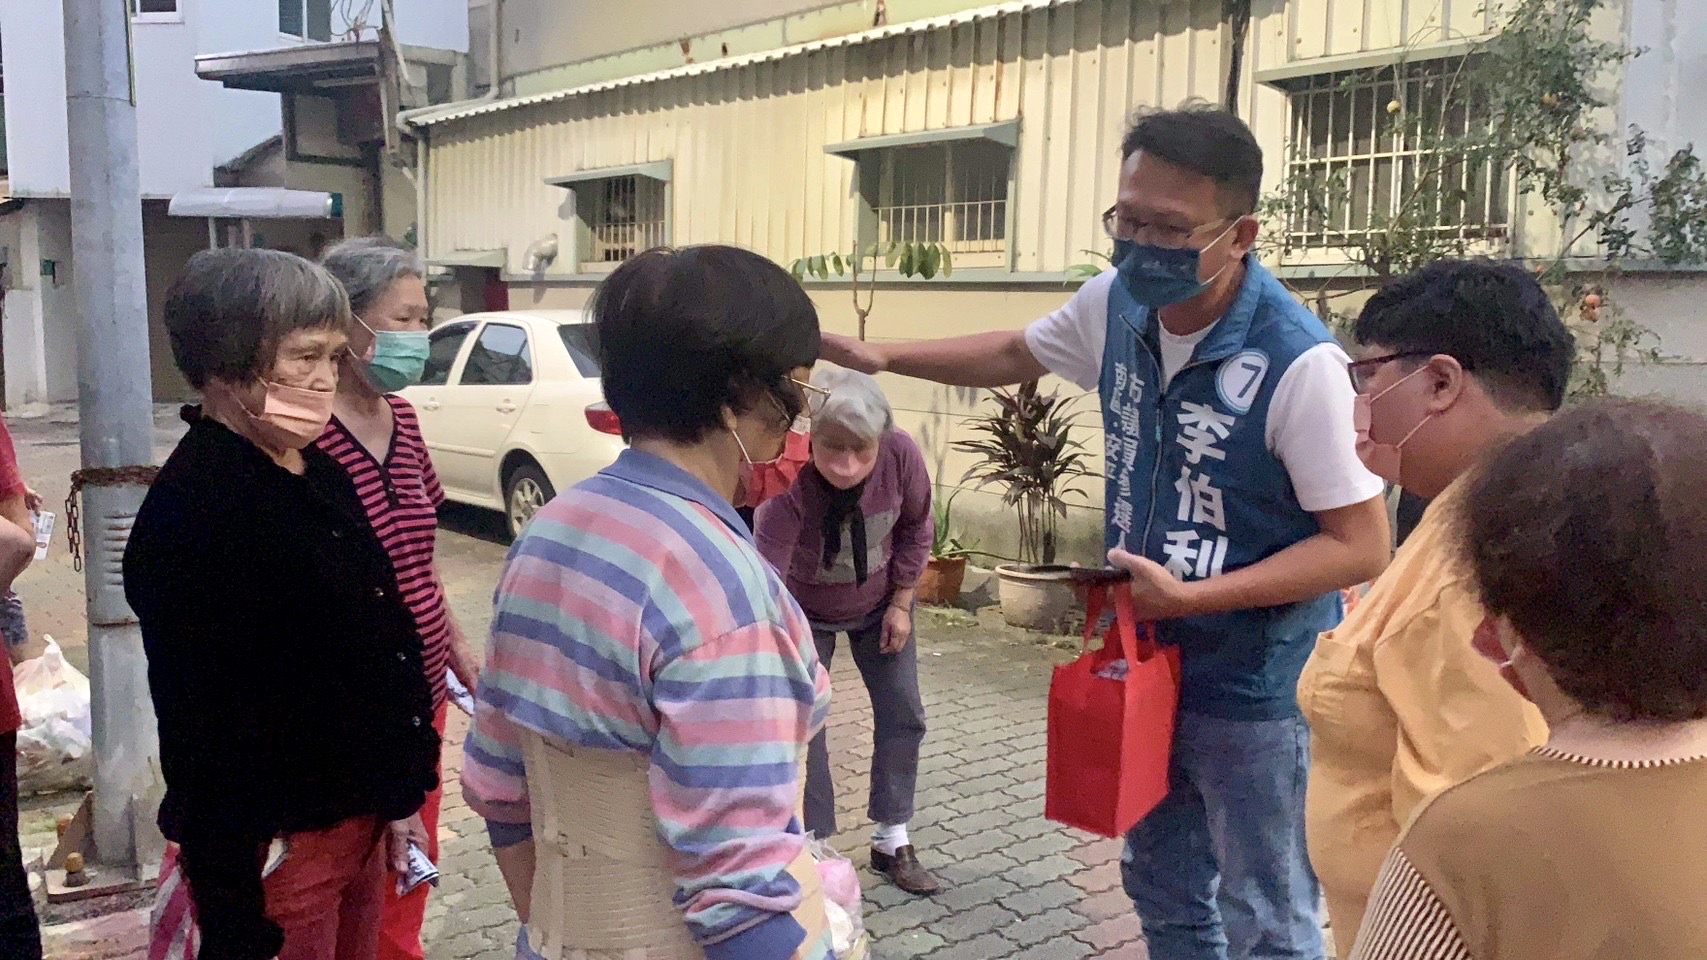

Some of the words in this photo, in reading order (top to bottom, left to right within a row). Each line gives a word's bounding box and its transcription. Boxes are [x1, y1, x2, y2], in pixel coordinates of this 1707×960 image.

[1240, 362, 1263, 399] 7
[1163, 400, 1236, 582] 李伯利
